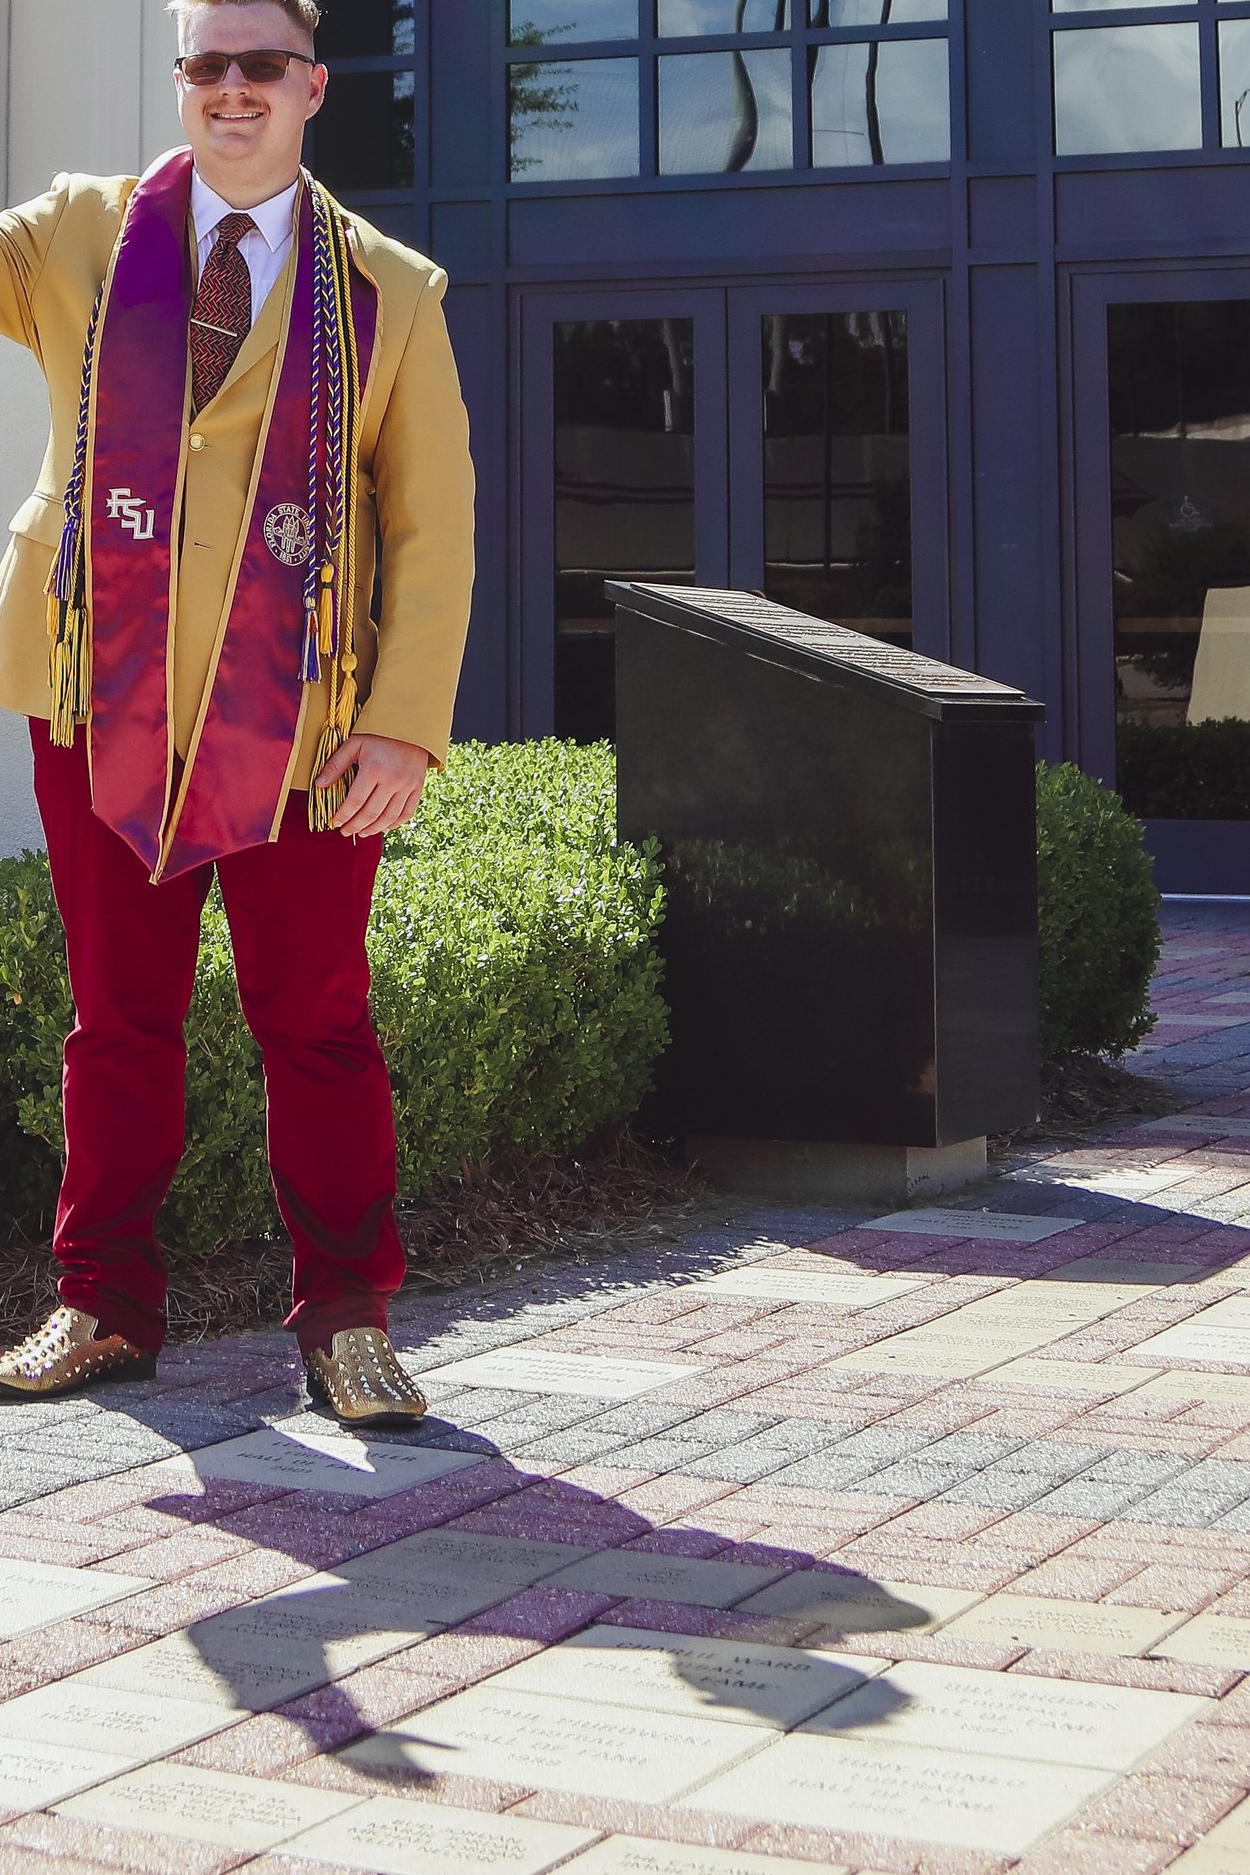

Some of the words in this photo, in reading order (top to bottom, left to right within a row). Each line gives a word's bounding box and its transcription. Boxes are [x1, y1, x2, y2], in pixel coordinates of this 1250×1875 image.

[106, 487, 154, 539] FSU
[265, 513, 277, 548] FLORIDA
[278, 505, 300, 516] STATE
[279, 552, 293, 563] 1851
[612, 1640, 720, 1660] CHARLIE
[726, 1655, 816, 1672] WARD
[693, 1675, 777, 1692] FAME
[473, 1705, 547, 1721] PAUL
[895, 1702, 970, 1717] HALL
[1020, 1717, 1106, 1735] FAME
[449, 1729, 523, 1746] HALL
[573, 1747, 655, 1766] FAME
[64, 1763, 101, 1773] OF
[171, 1780, 265, 1800] MICHAEL
[782, 1777, 859, 1794] HALL
[915, 1794, 1004, 1813] FAME
[226, 1803, 309, 1822] OMEGA
[437, 1825, 526, 1844] JORDAN
